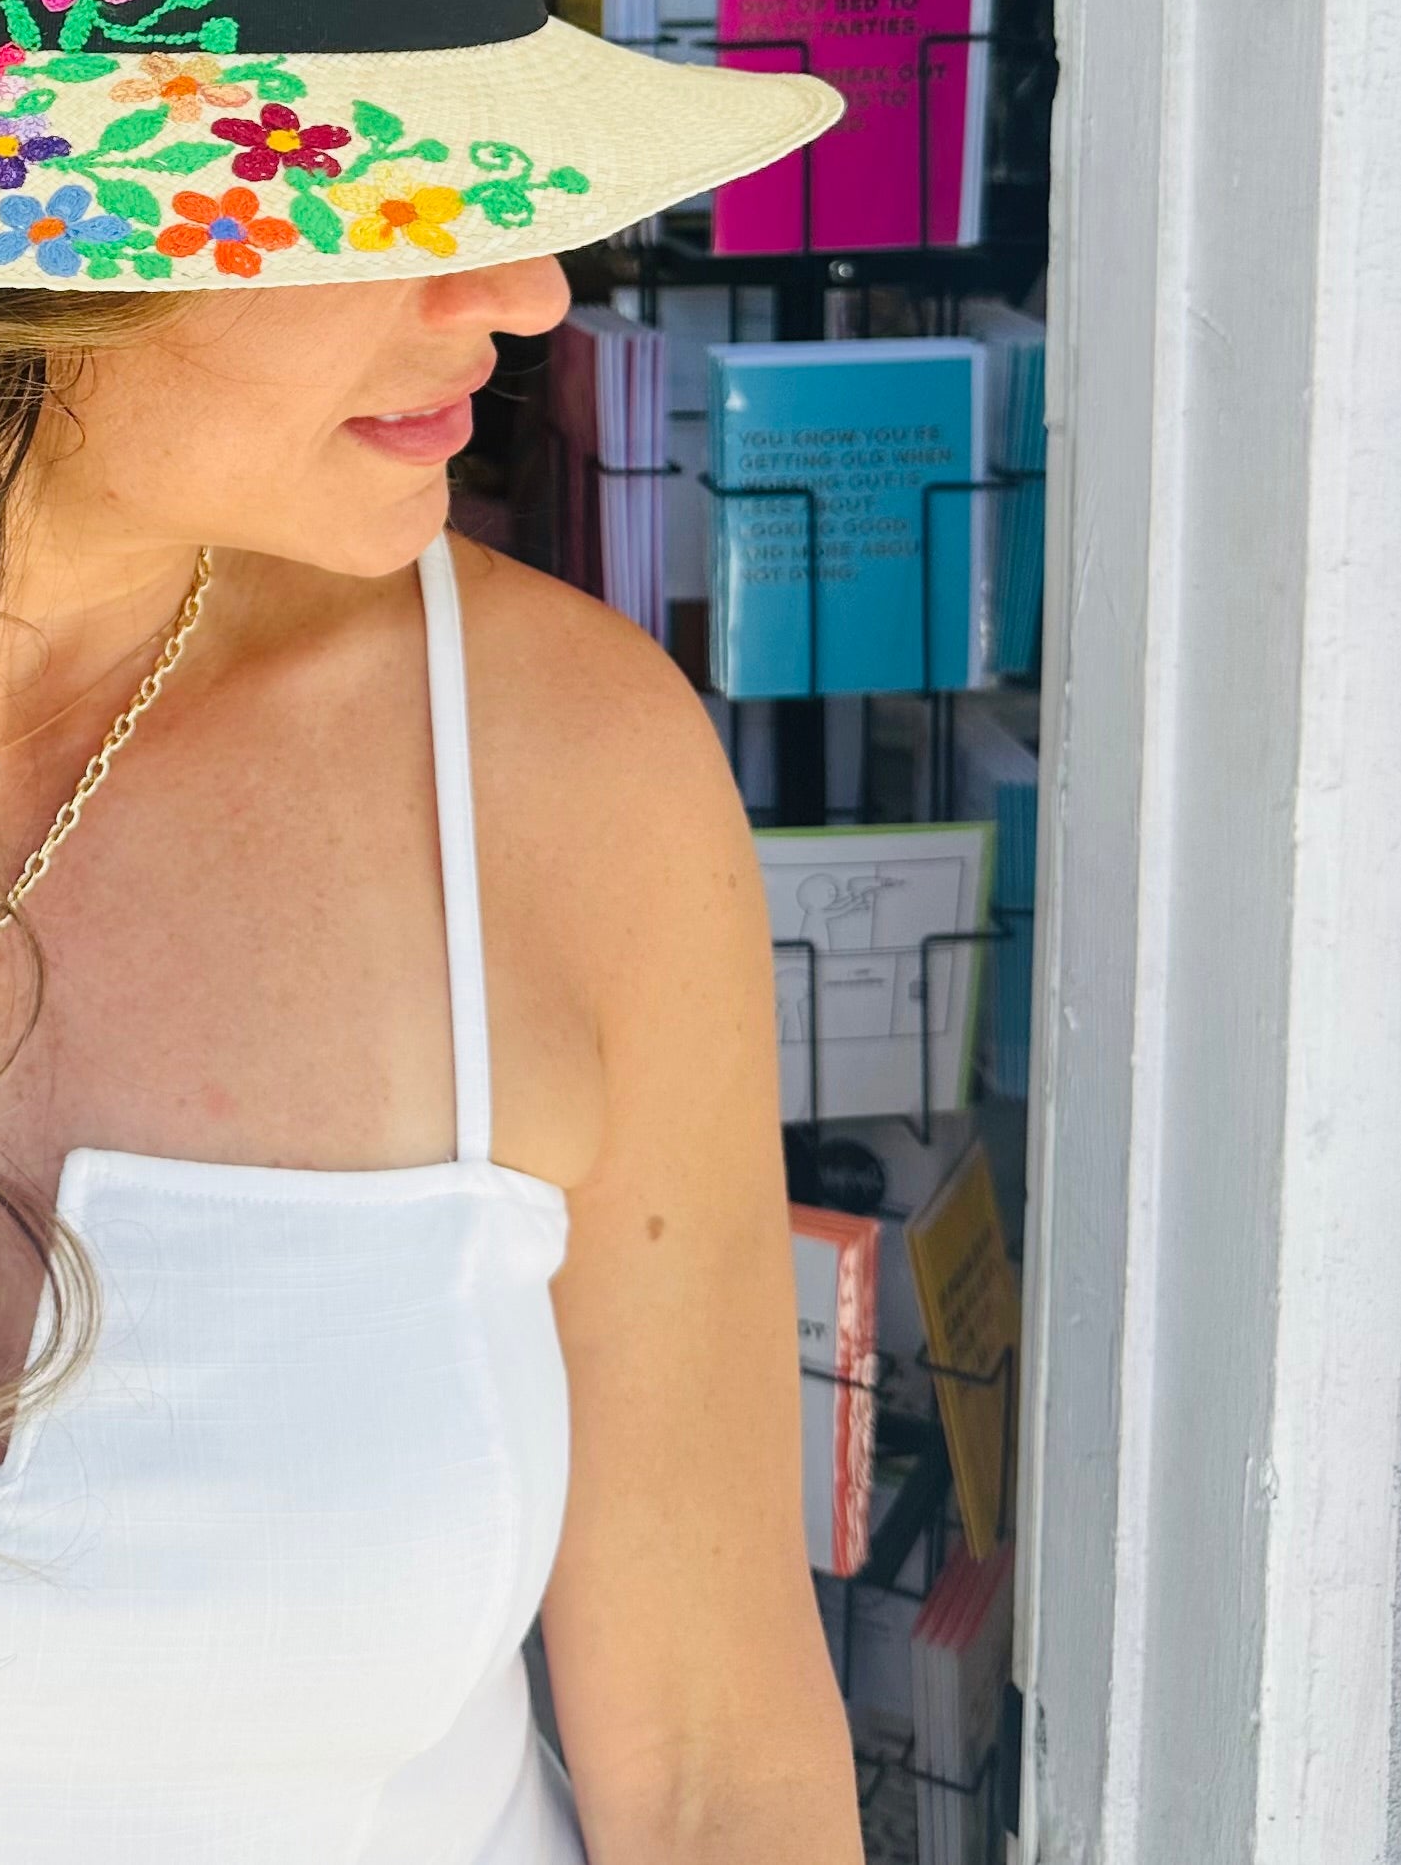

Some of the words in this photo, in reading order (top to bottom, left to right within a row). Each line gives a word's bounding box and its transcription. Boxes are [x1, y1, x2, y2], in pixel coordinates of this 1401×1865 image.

[898, 62, 948, 84] OT
[738, 429, 784, 449] YOU
[791, 427, 856, 448] KNOW
[738, 450, 833, 473] GETTING
[839, 448, 886, 470] OLD
[892, 447, 953, 468] WHEN
[847, 471, 893, 492] OUT
[738, 518, 838, 540] LOOKIG
[842, 515, 909, 537] GOOD
[790, 540, 856, 562] MRE
[861, 539, 922, 560] ABOU
